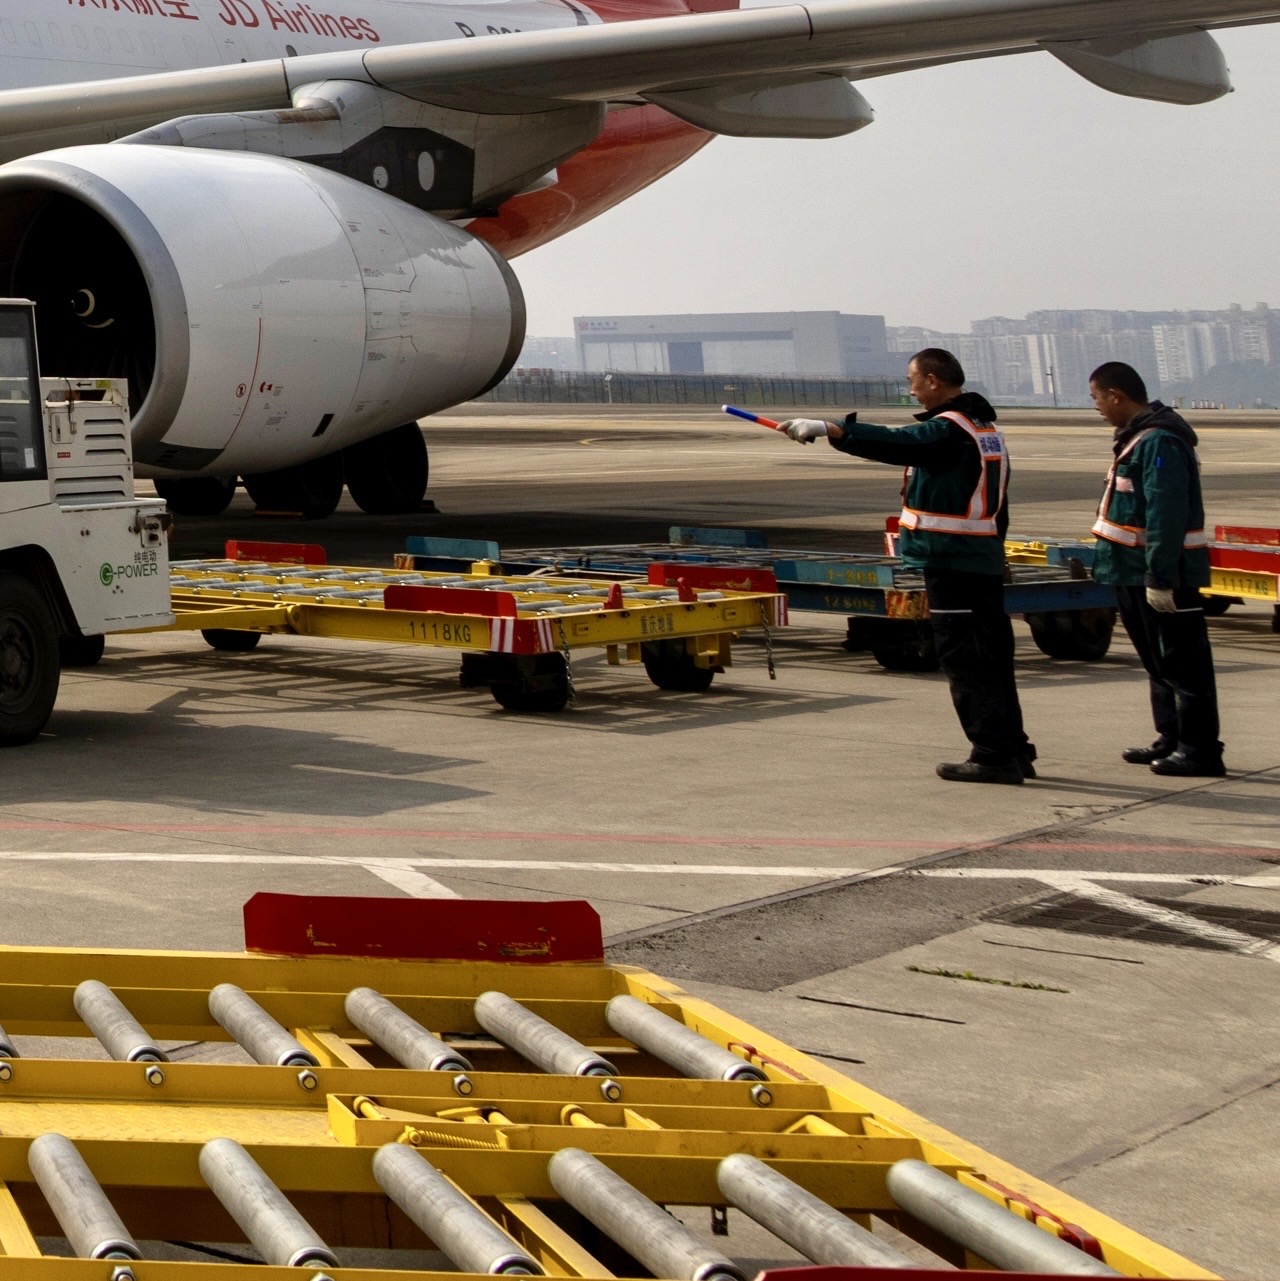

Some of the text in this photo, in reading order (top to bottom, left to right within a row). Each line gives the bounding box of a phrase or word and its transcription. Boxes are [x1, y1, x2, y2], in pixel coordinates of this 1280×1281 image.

[261, 0, 380, 43] Airlines
[134, 550, 157, 563] 纯电动
[409, 621, 471, 642] 1118KG
